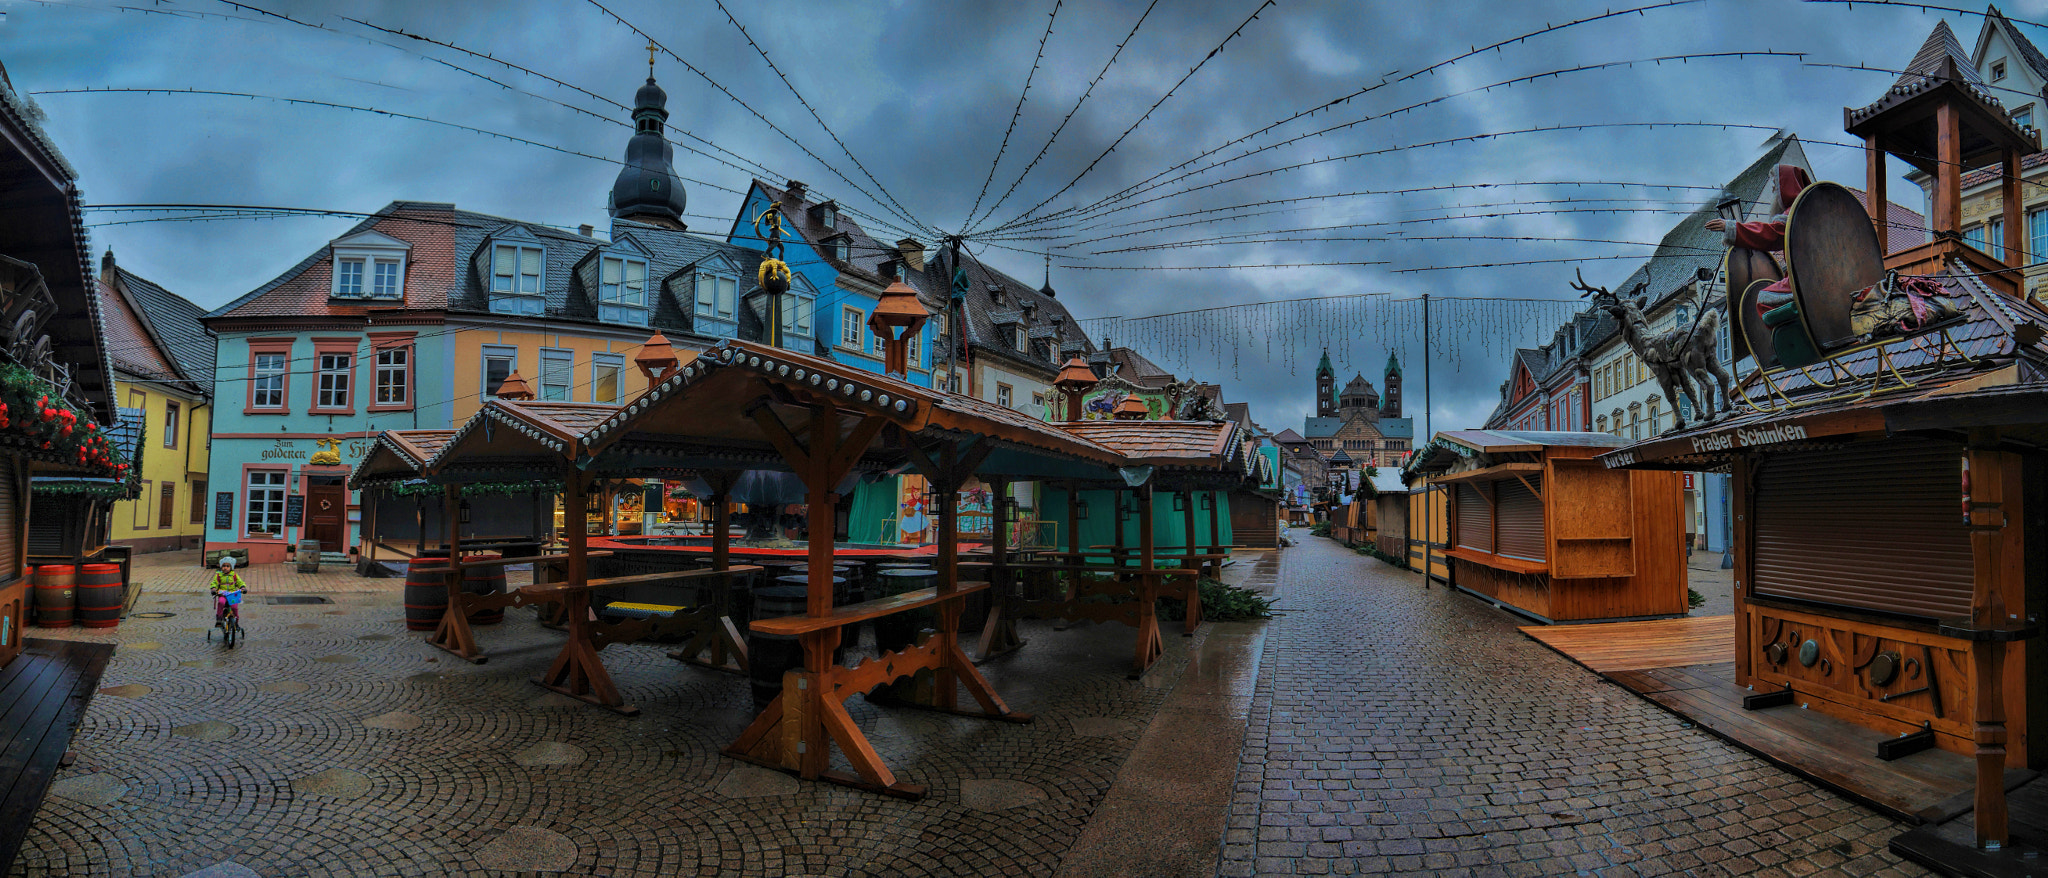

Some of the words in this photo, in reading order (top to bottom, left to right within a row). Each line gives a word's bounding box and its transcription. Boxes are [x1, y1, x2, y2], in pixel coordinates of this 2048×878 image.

[274, 439, 294, 448] Zum
[1691, 433, 1733, 453] Prager
[1737, 422, 1808, 447] Schinken
[261, 447, 306, 461] goldenen
[1602, 452, 1636, 469] Burger
